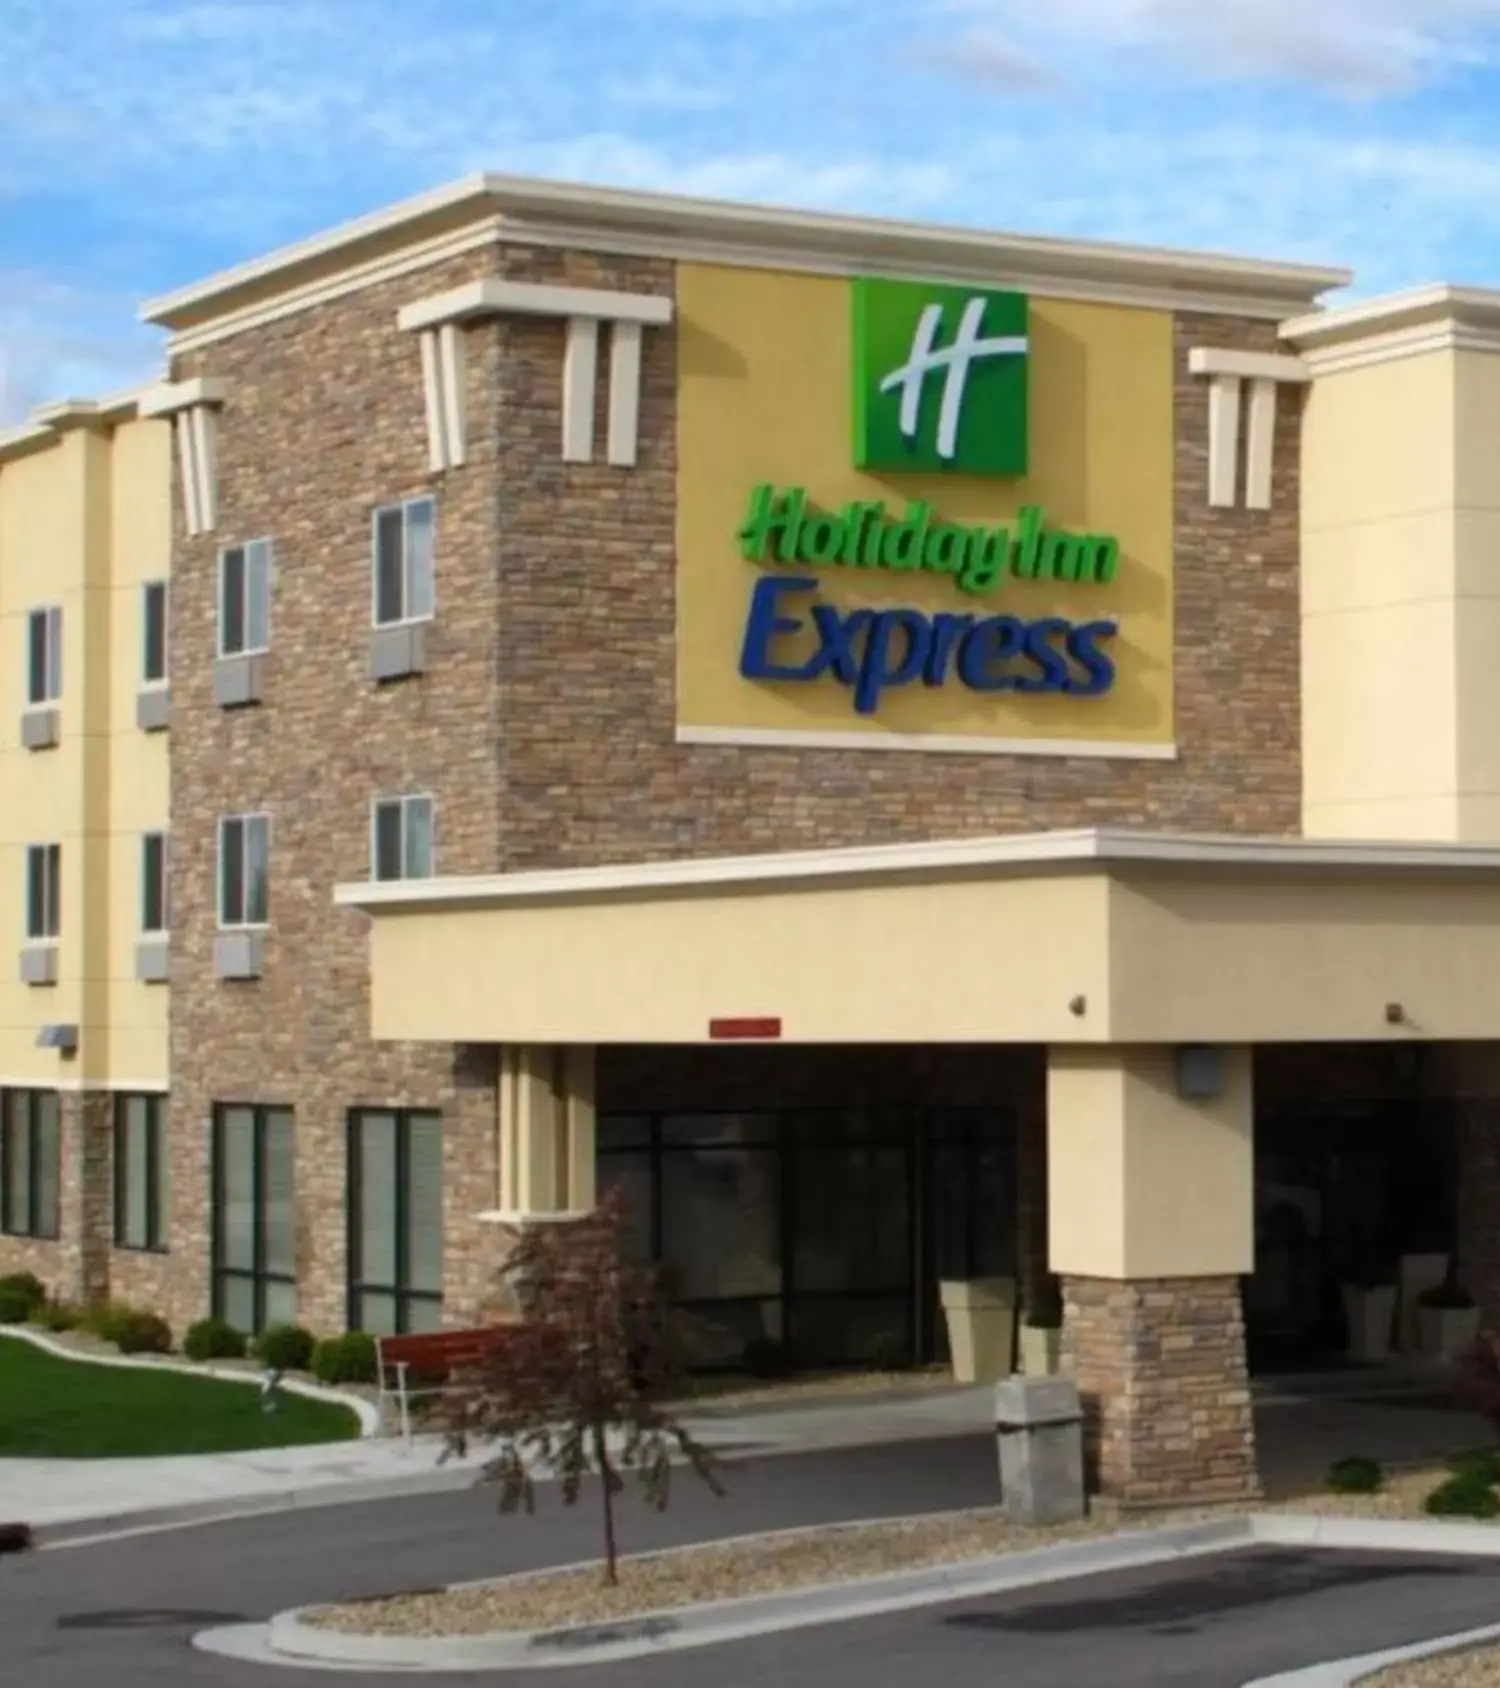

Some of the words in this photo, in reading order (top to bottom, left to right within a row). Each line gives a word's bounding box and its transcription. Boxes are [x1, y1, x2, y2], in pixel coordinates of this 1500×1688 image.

[880, 297, 1028, 459] H
[737, 483, 1009, 595] Holiday
[1012, 505, 1119, 585] Inn
[739, 575, 1118, 715] Express
